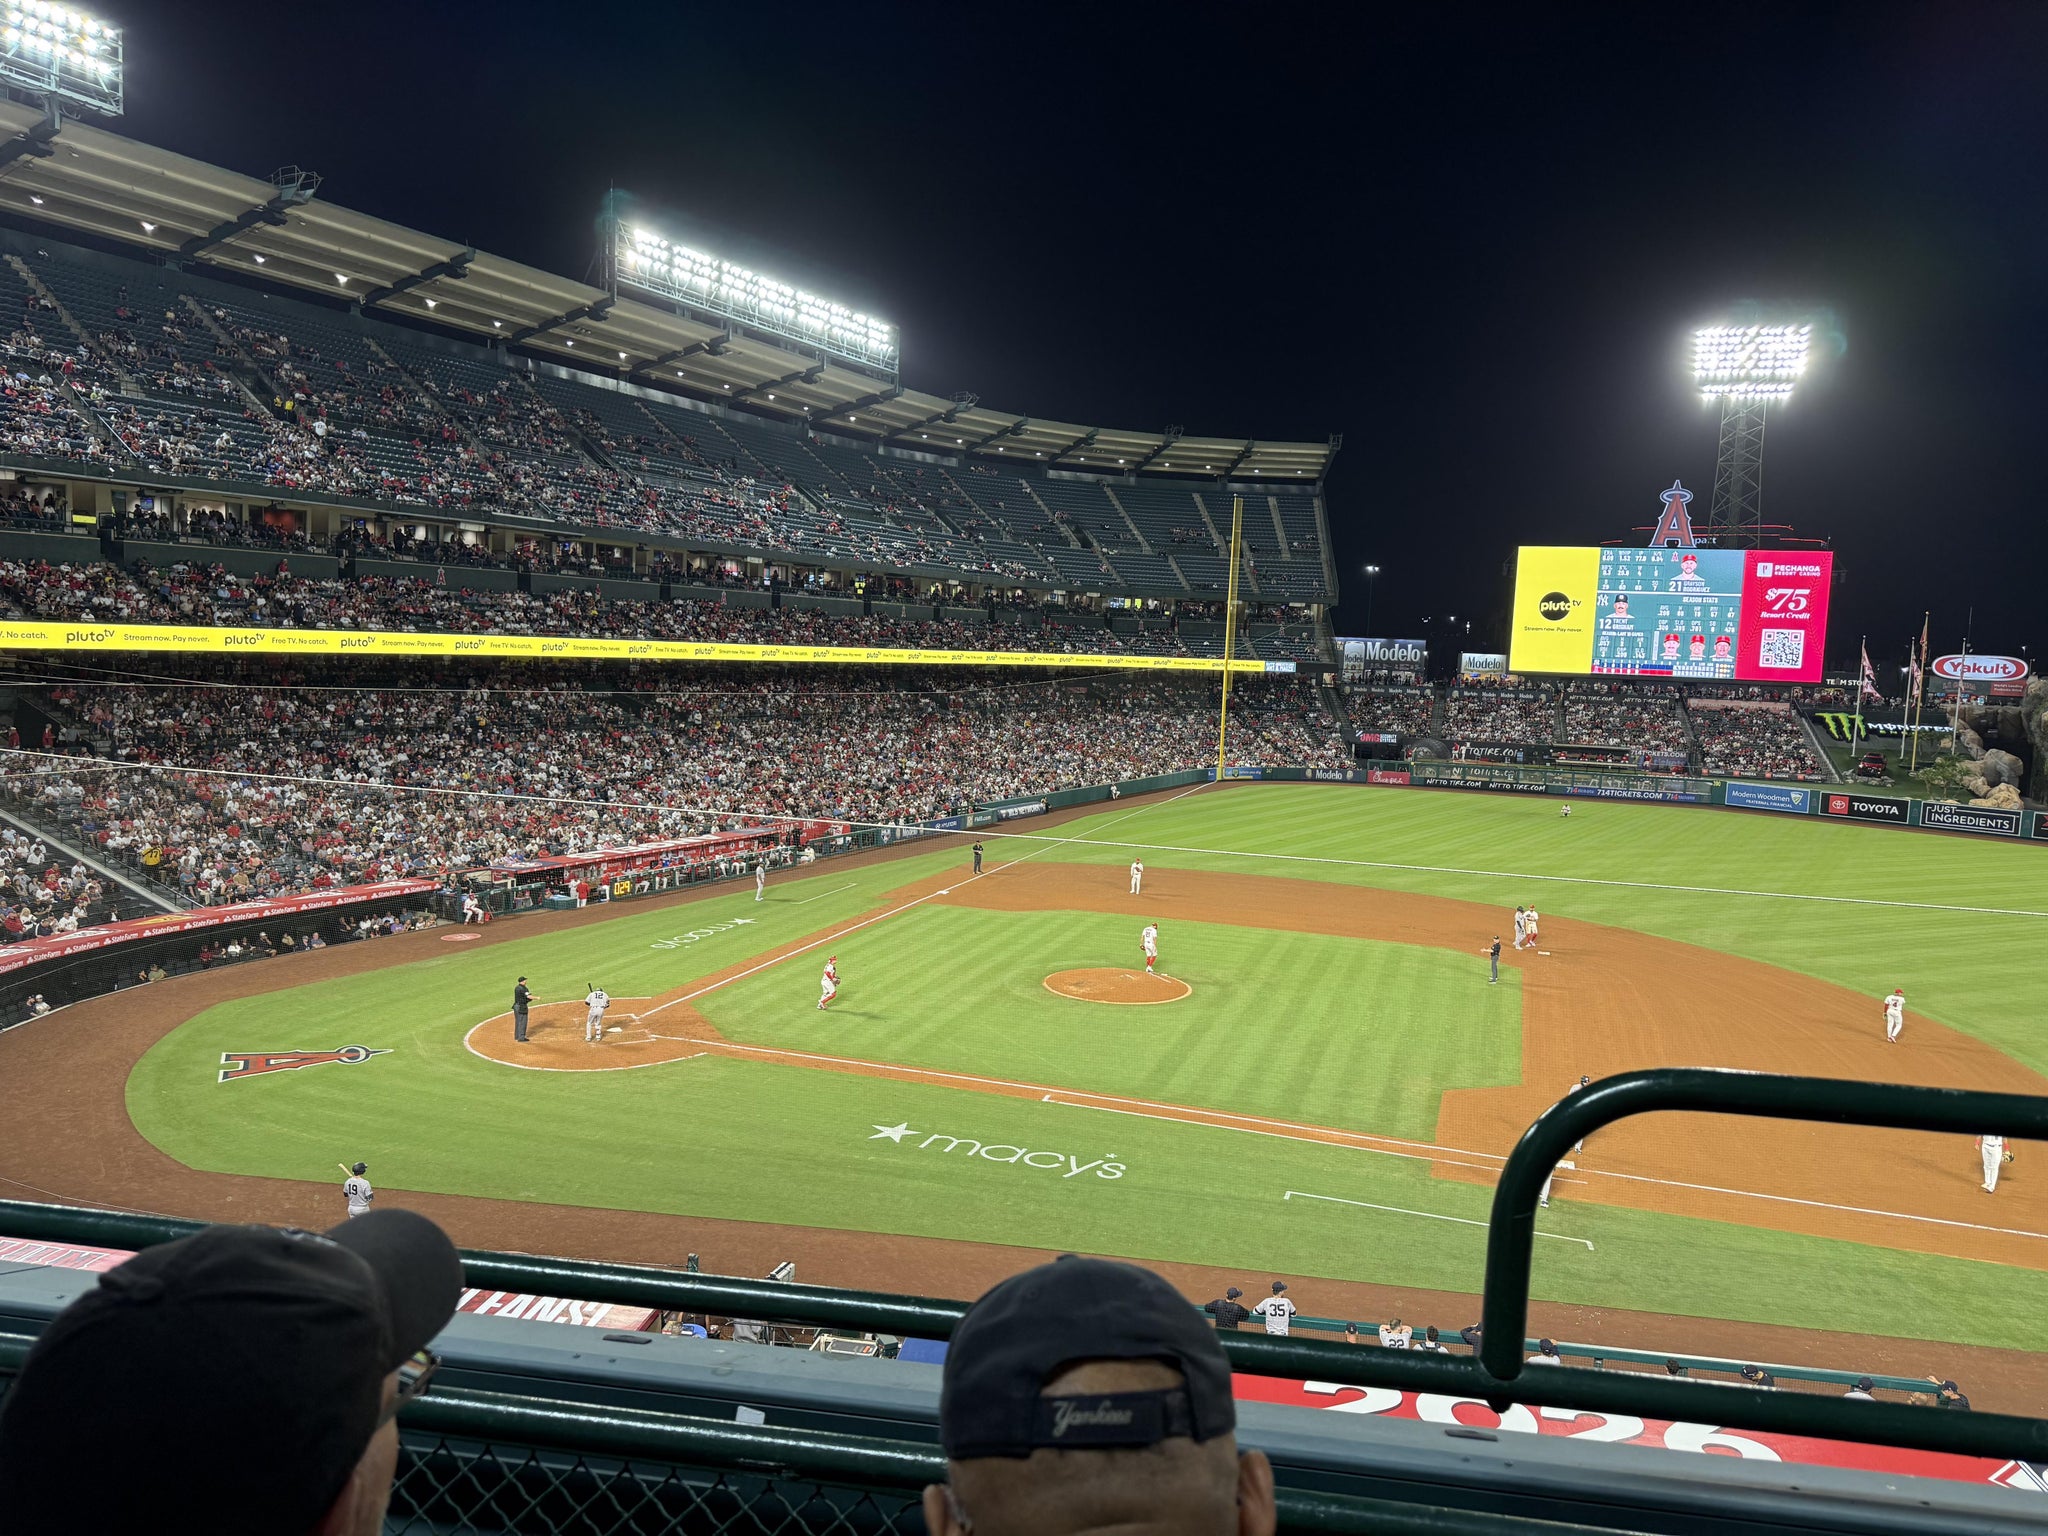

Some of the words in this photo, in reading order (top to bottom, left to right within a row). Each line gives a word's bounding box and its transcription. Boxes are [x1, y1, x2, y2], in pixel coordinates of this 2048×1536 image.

[1669, 581, 1682, 592] 21
[1765, 588, 1810, 610] $75
[1540, 600, 1570, 612] pluto
[1600, 618, 1612, 629] 12
[66, 631, 104, 643] pluto
[104, 629, 115, 637] tv
[224, 636, 257, 646] pluto
[341, 639, 368, 648] pluto
[455, 641, 478, 650] pluto
[542, 643, 563, 652] pluto
[629, 646, 647, 654] pluto
[695, 647, 711, 656] pluto
[1366, 642, 1420, 662] Modelo
[1468, 656, 1501, 669] Modelo
[1950, 662, 2011, 674] Yakult
[1316, 770, 1342, 779] Modelo
[1450, 780, 1481, 788] TIRE.COM
[1597, 789, 1662, 799] 714TICKETS.COM
[1732, 790, 1756, 798] Modern
[1758, 793, 1790, 802] Woodmen
[1852, 802, 1899, 815] TOYOTA
[1931, 805, 1957, 814] JUST
[1932, 813, 2010, 829] INGREDIENTS
[348, 1184, 358, 1195] 19
[1270, 1304, 1285, 1317] 35
[1389, 1339, 1404, 1348] 22
[1053, 1400, 1133, 1437] Yankees
